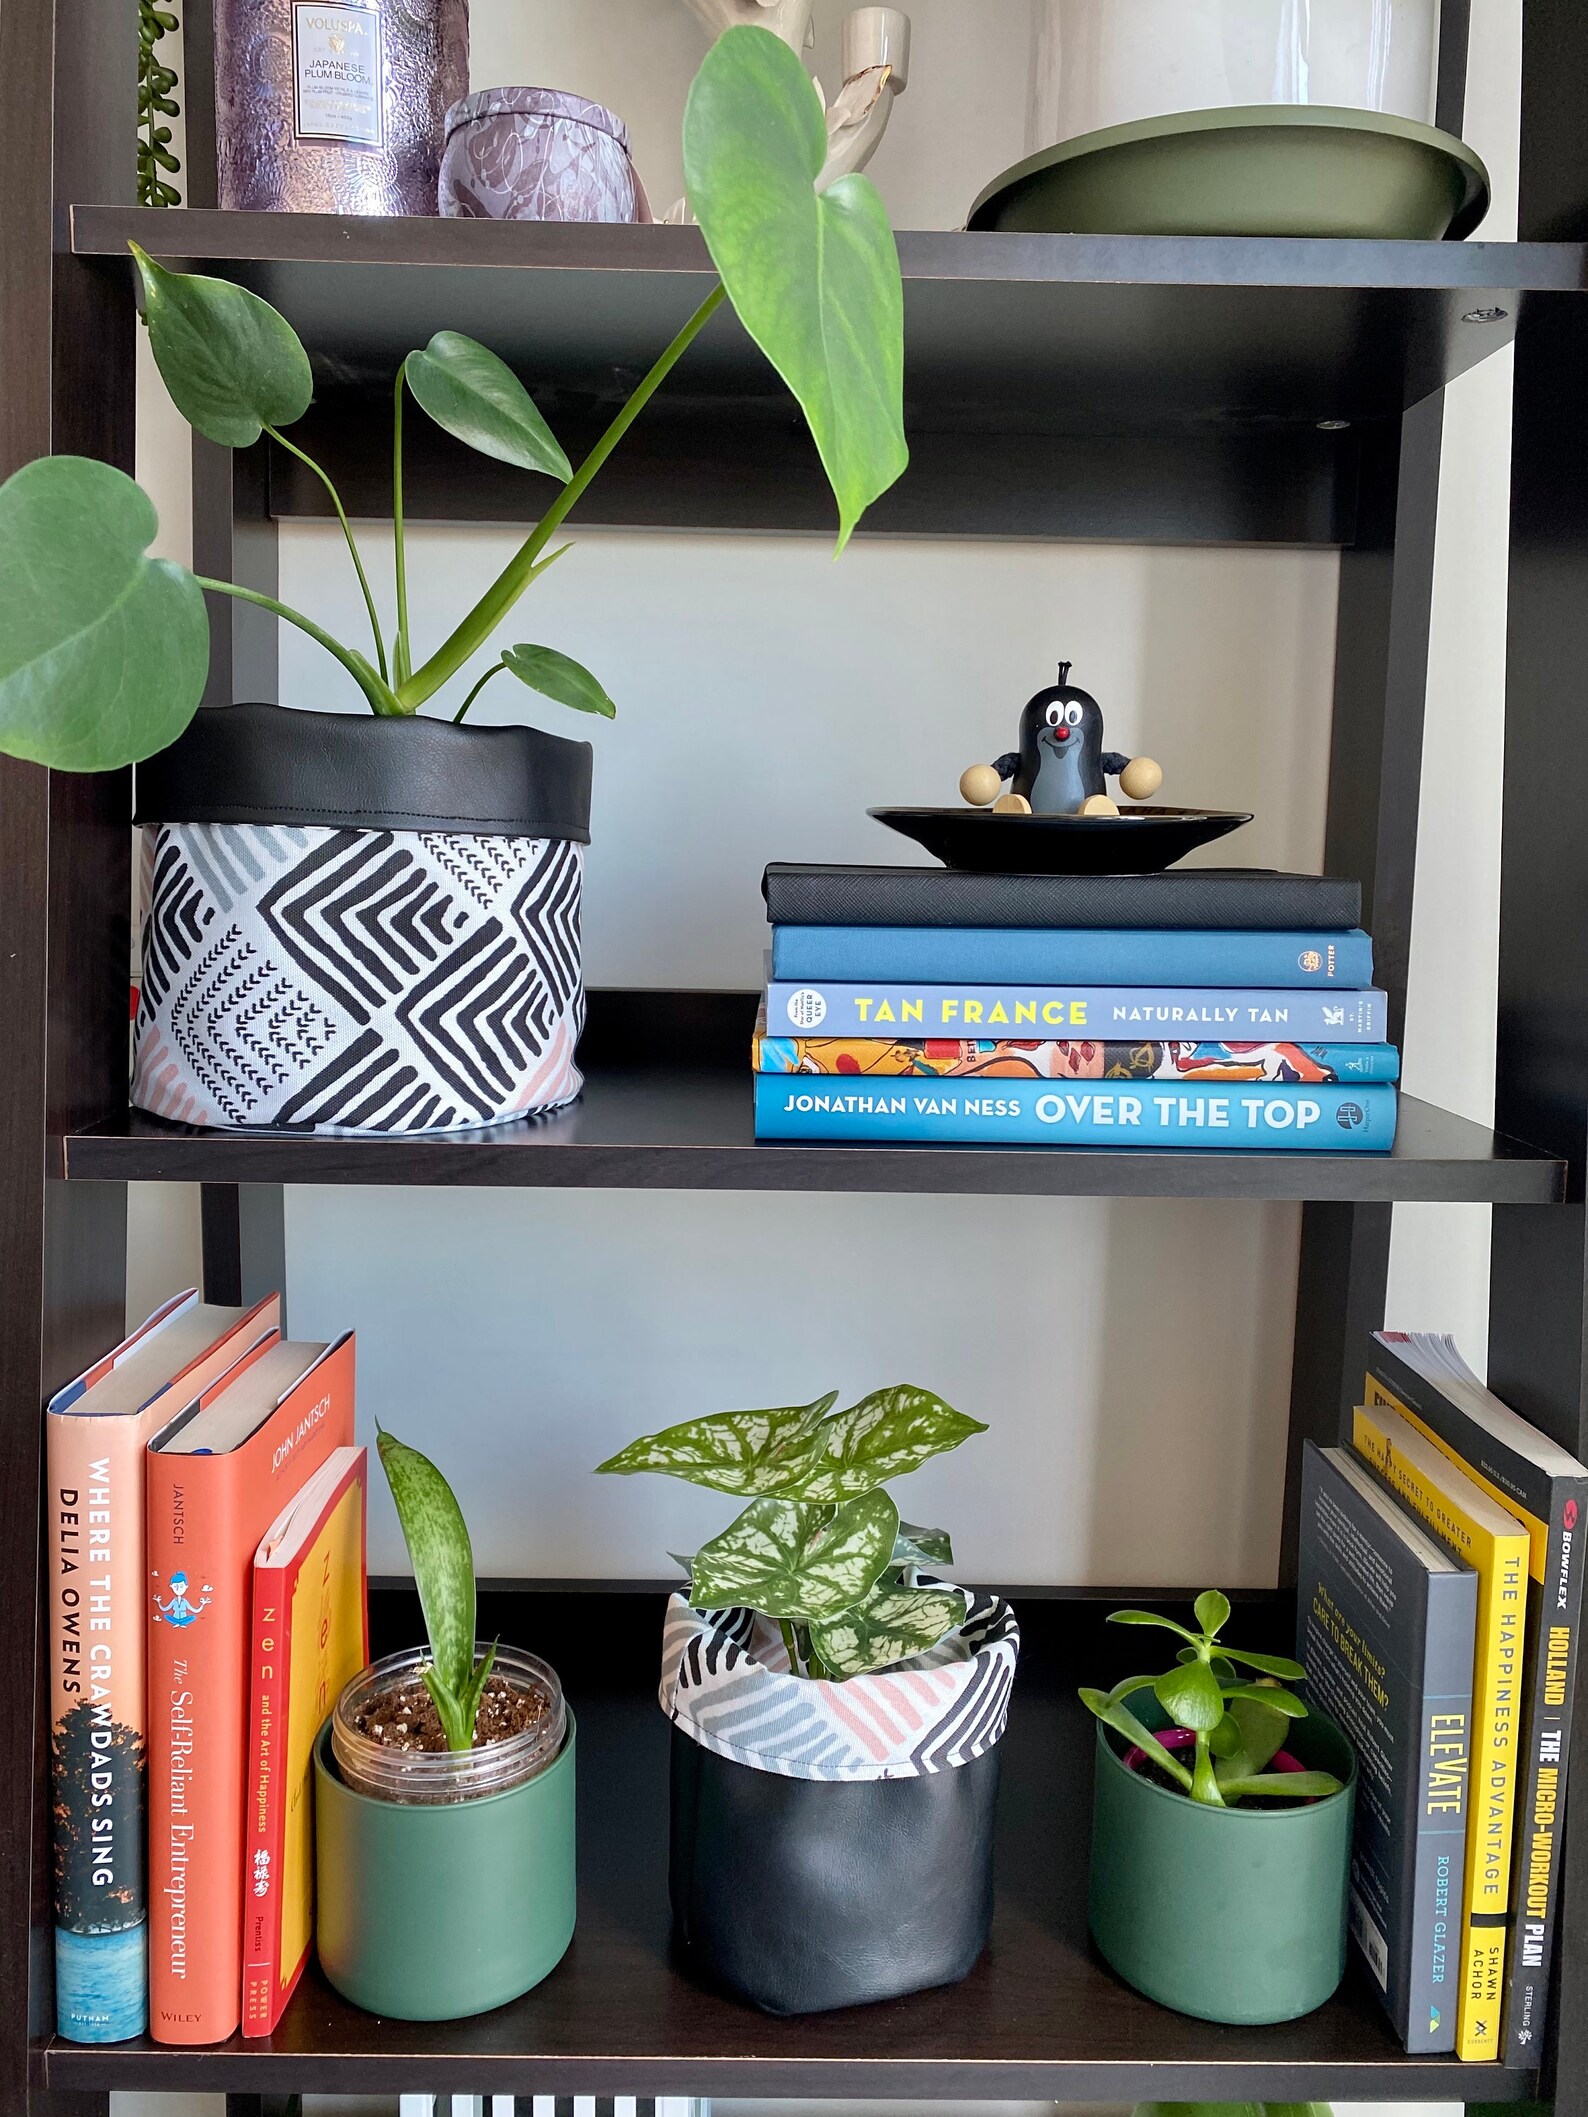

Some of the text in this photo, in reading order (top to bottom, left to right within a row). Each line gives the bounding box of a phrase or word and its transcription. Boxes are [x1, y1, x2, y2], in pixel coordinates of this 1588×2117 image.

[304, 69, 333, 79] PLUM
[309, 60, 365, 74] JAPANESE
[1327, 944, 1335, 977] POTTER
[854, 998, 1289, 1025] TAN FRANCE NATURALLY TAN
[784, 1094, 1321, 1130] JONATHAN VAN NESS OVER THE TOP
[271, 1439, 294, 1474] JOHN
[295, 1393, 330, 1447] JANTSCH
[173, 1484, 184, 1545] JANTSCH
[1364, 1434, 1375, 1453] THE
[1398, 1468, 1423, 1503] SECRET
[1425, 1494, 1434, 1514] TO
[1436, 1506, 1472, 1549] GREATER
[60, 1488, 80, 1693] DELIA OWENS
[1556, 1531, 1573, 1610] BOWFLEX
[1312, 1595, 1389, 1711] CARE TO BREAK THEM?
[1317, 1581, 1386, 1678] What are your limits?
[88, 1457, 114, 1886] WHERE THE CRAWDADS SING
[1483, 1556, 1520, 1895] THE HAPPINESS ADVANTAGE
[257, 1694, 270, 1833] and the Art of Happiness
[1427, 1713, 1468, 1816] ELEVATE
[1522, 1626, 1571, 1967] HOLLAND THE MICRO-WORKOUT PLAN
[163, 1659, 194, 1979] The Self-Reliant Entrepreneur
[254, 1915, 264, 1952] Prentiss
[1432, 1855, 1450, 1984] ROBERT GLAZER
[249, 1981, 257, 2019] PRESS
[260, 1980, 268, 2019] POWER
[1470, 1949, 1483, 2000] ACHOR
[1486, 1946, 1499, 2001] SHAWN
[1522, 1984, 1534, 2028] STERLING
[71, 2013, 109, 2022] PUTNAM
